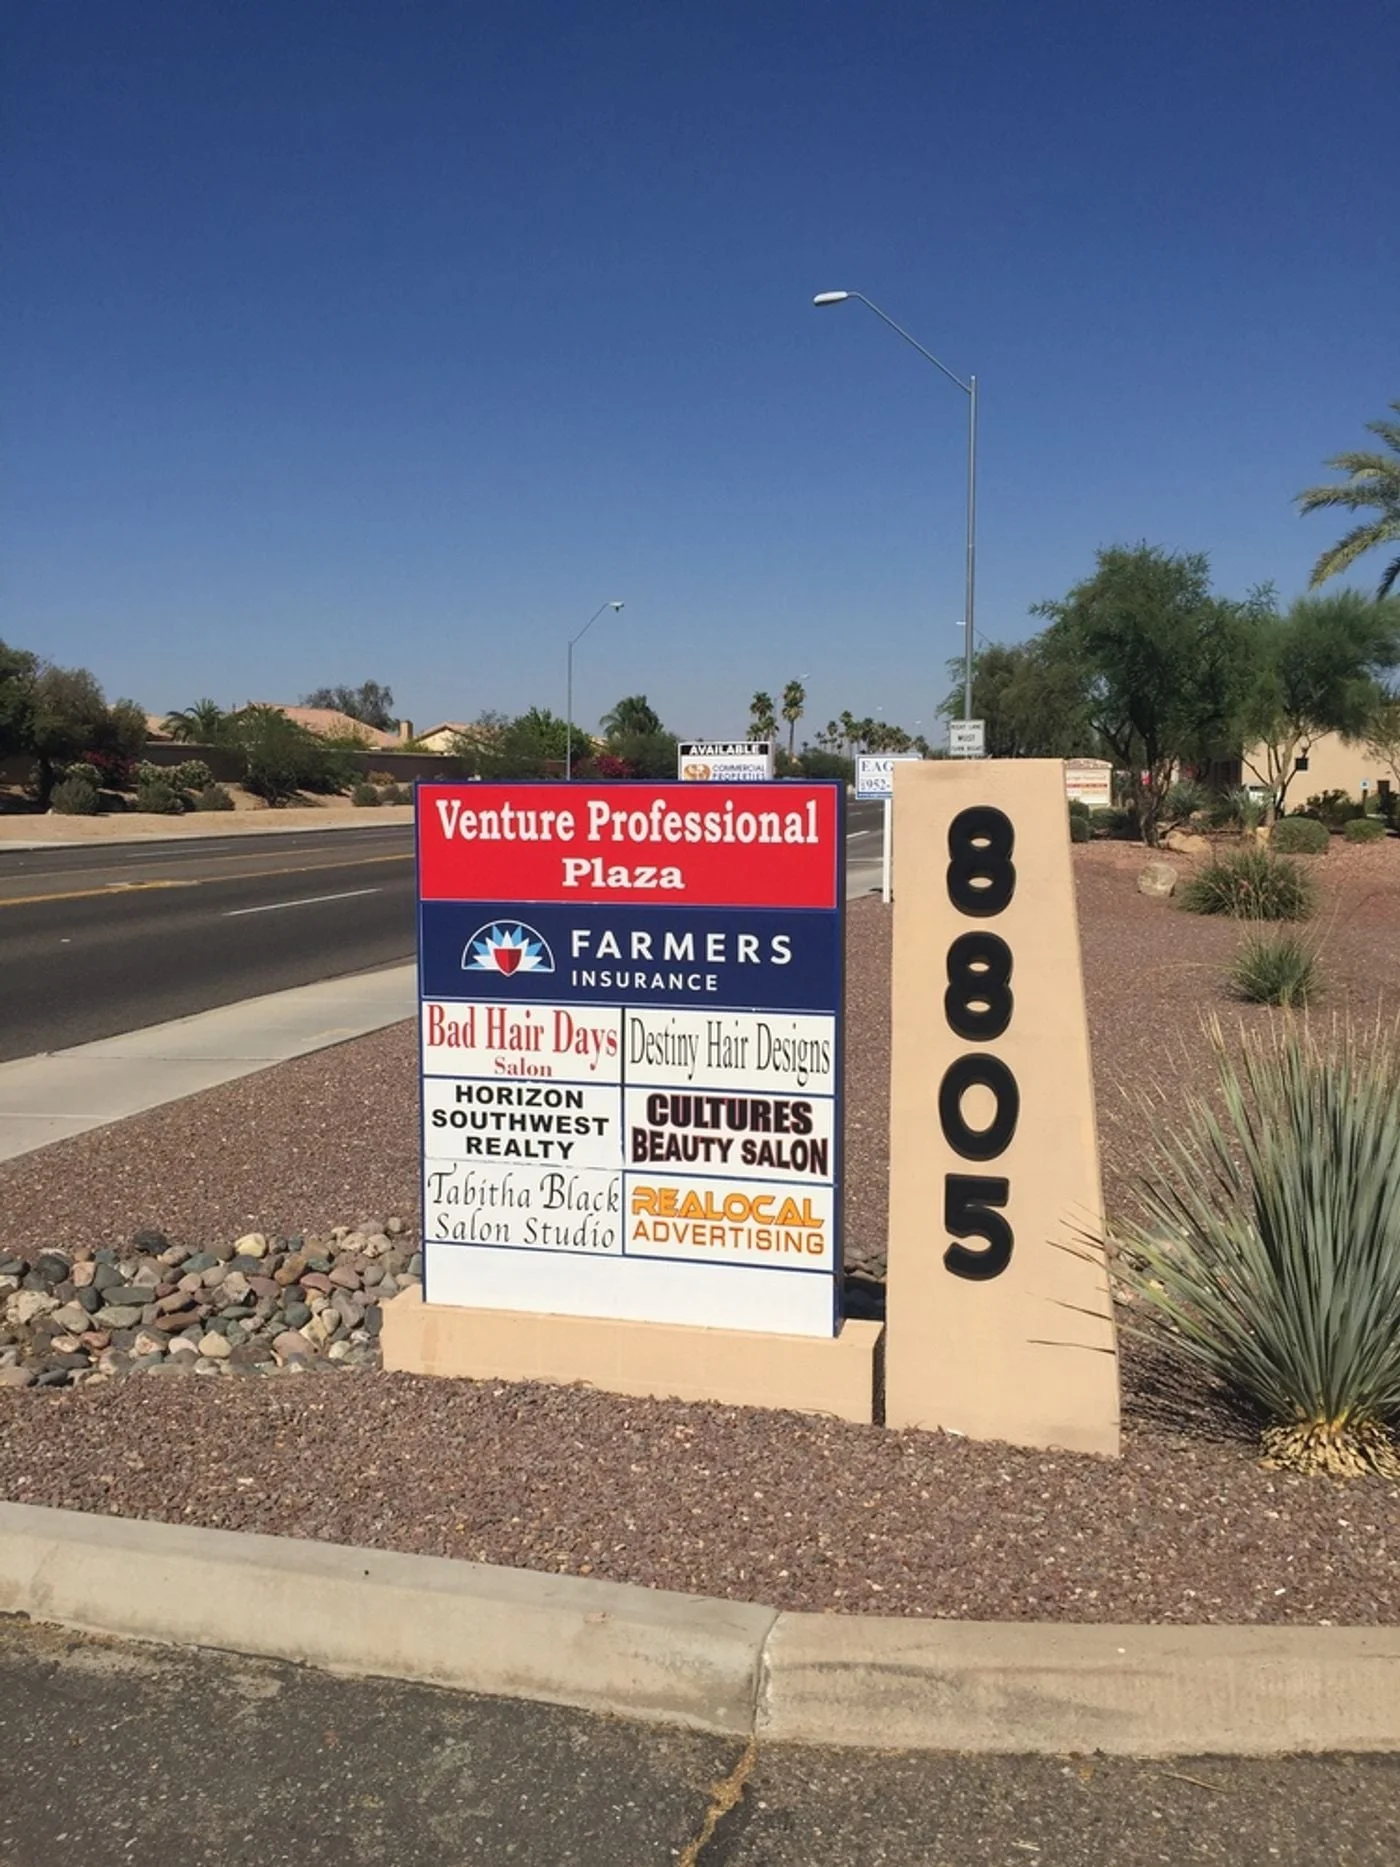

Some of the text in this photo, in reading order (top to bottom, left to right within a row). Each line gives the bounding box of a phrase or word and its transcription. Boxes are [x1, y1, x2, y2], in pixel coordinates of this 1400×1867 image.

[689, 745, 759, 754] AVAILABLE
[435, 799, 819, 845] Venture Professional
[562, 857, 684, 890] Plaza
[571, 929, 793, 965] FARMERS
[572, 970, 718, 992] INSURANCE
[427, 1004, 617, 1070] Bad Hair Days
[630, 1016, 831, 1087] Destiny Hair Designs
[938, 805, 1020, 1282] 8805
[493, 1056, 552, 1078] Salon
[456, 1085, 584, 1109] HORIZON
[646, 1093, 813, 1135] CULTURES
[432, 1109, 609, 1136] SOUTHWEST
[466, 1136, 575, 1160] REALTY
[632, 1128, 828, 1176] BEAUTY SALON
[427, 1164, 620, 1213] Tabitha Black
[632, 1185, 824, 1228] REALOCAL
[435, 1208, 615, 1249] Salon Studio
[633, 1220, 824, 1255] ADVERTISING
